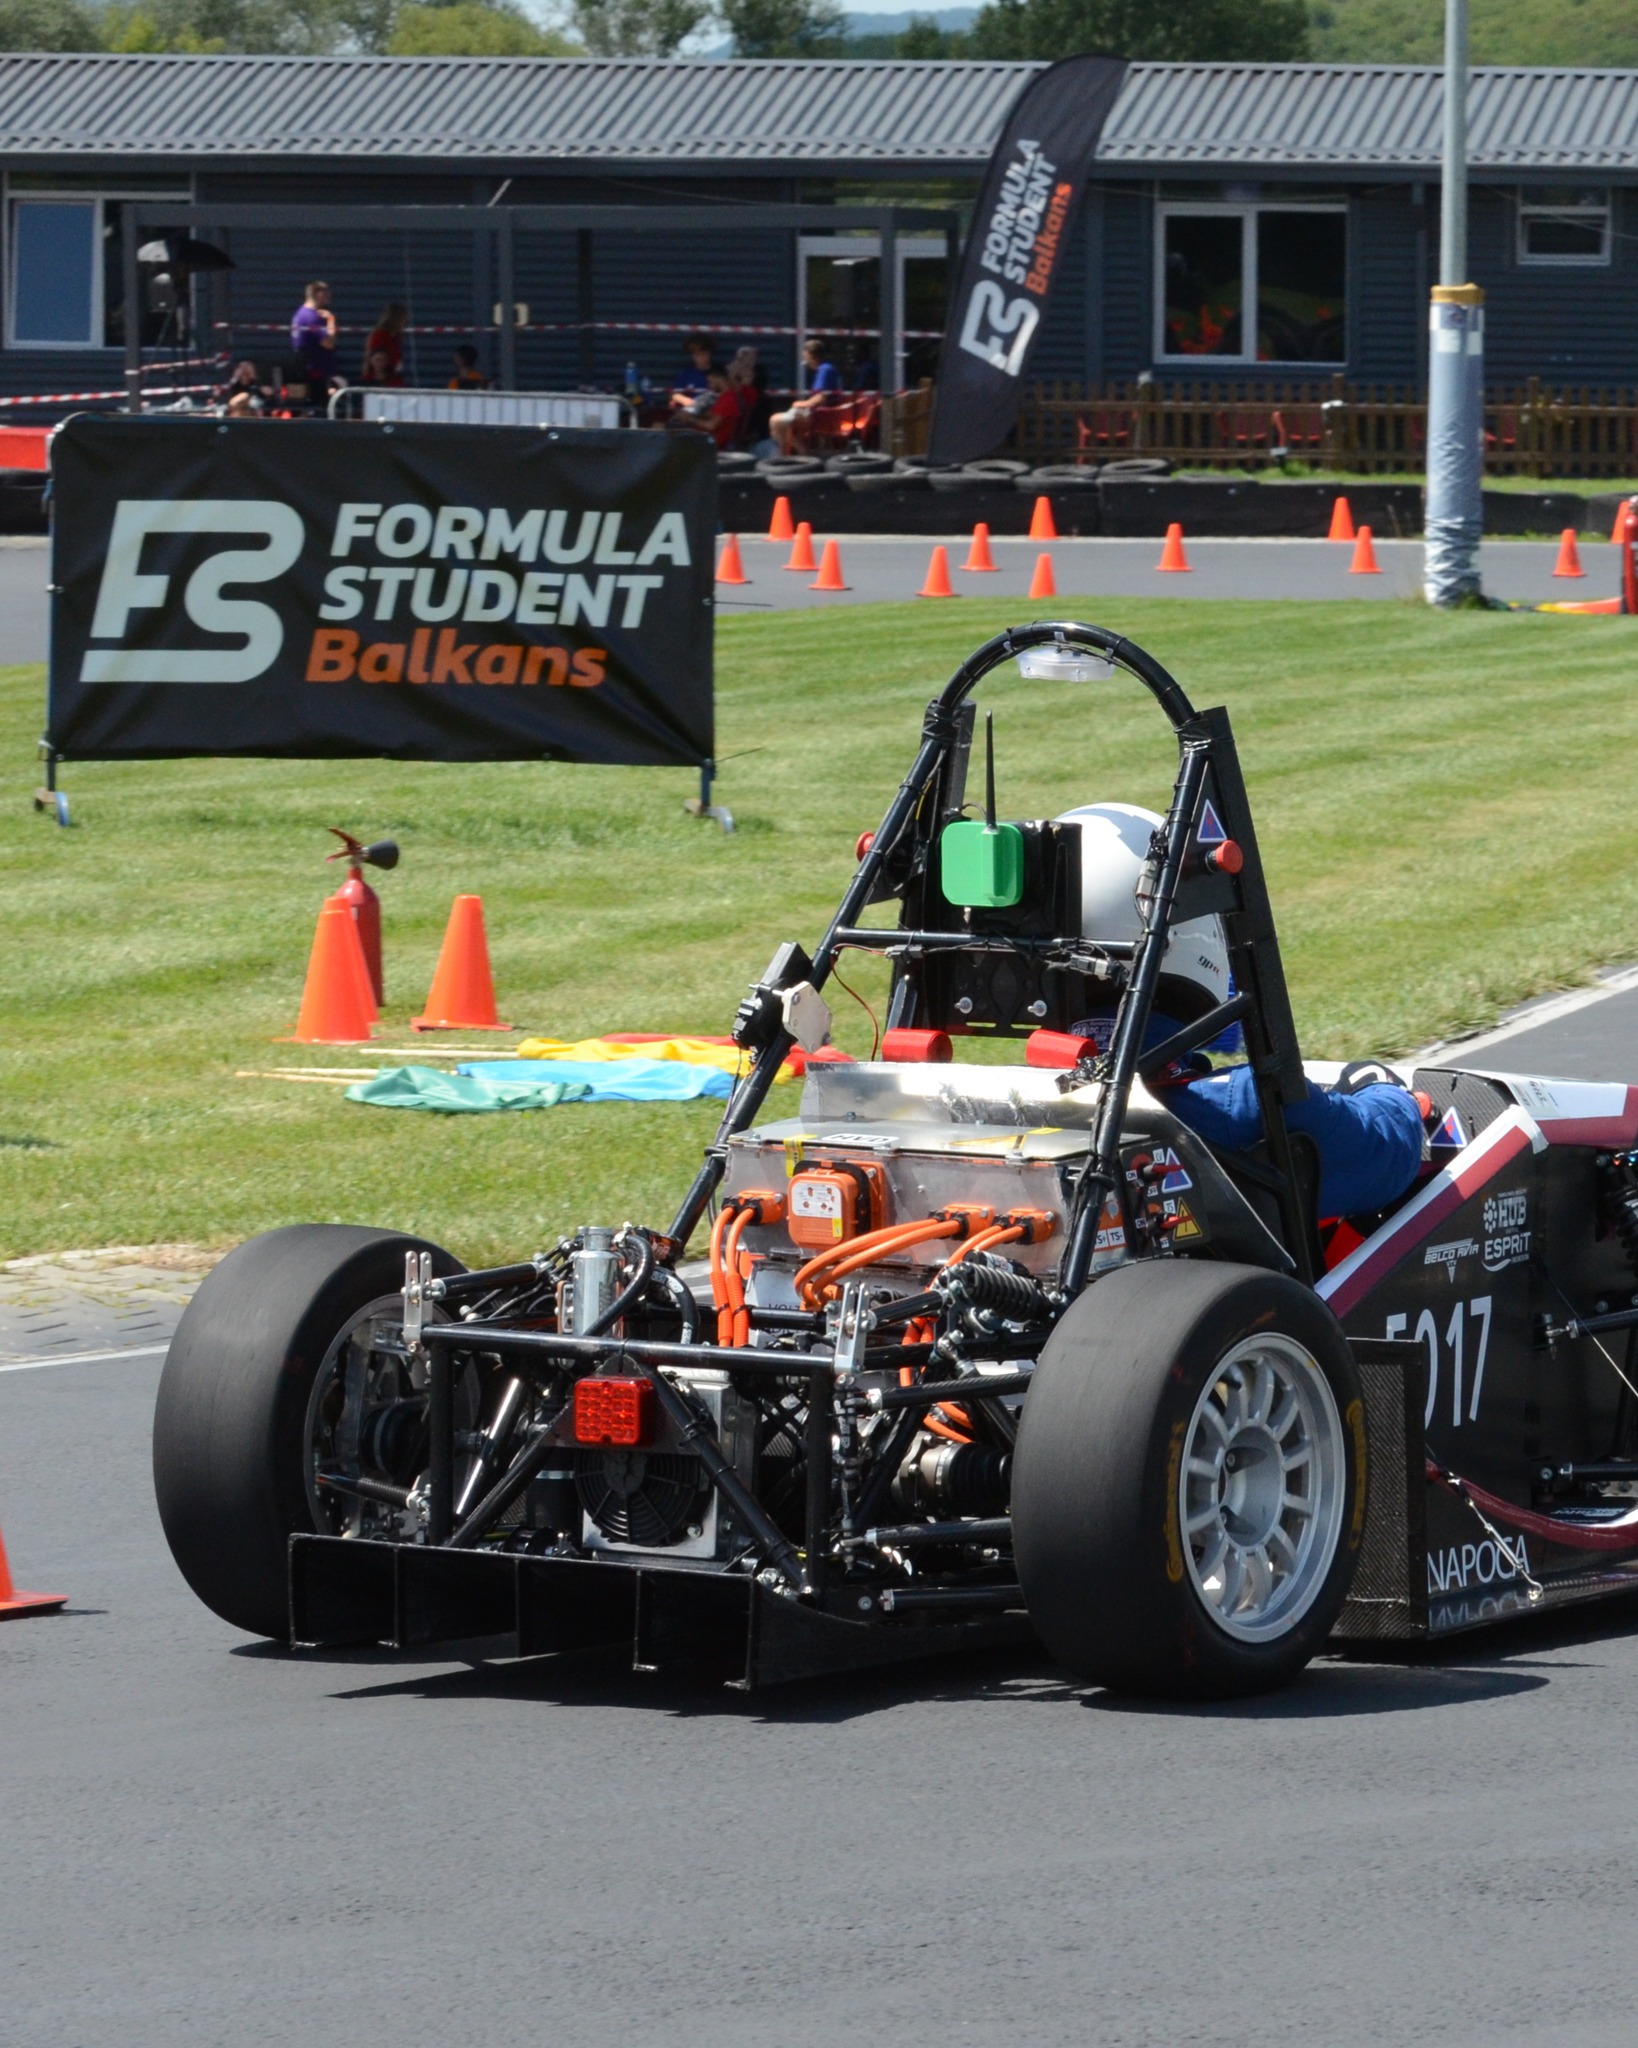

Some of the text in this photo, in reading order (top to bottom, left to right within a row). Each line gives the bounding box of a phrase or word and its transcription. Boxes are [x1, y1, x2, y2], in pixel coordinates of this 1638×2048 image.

[980, 139, 1040, 274] FORMULA
[1003, 152, 1057, 285] STUDENT
[1025, 182, 1073, 295] Balkans
[330, 503, 692, 567] FORMULA
[79, 499, 305, 684] FS
[318, 565, 664, 629] STUDENT
[305, 627, 608, 688] Balkans
[1498, 1195, 1527, 1228] HUB
[1386, 1295, 1492, 1431] 017
[1427, 1534, 1531, 1594] NAPOCA
